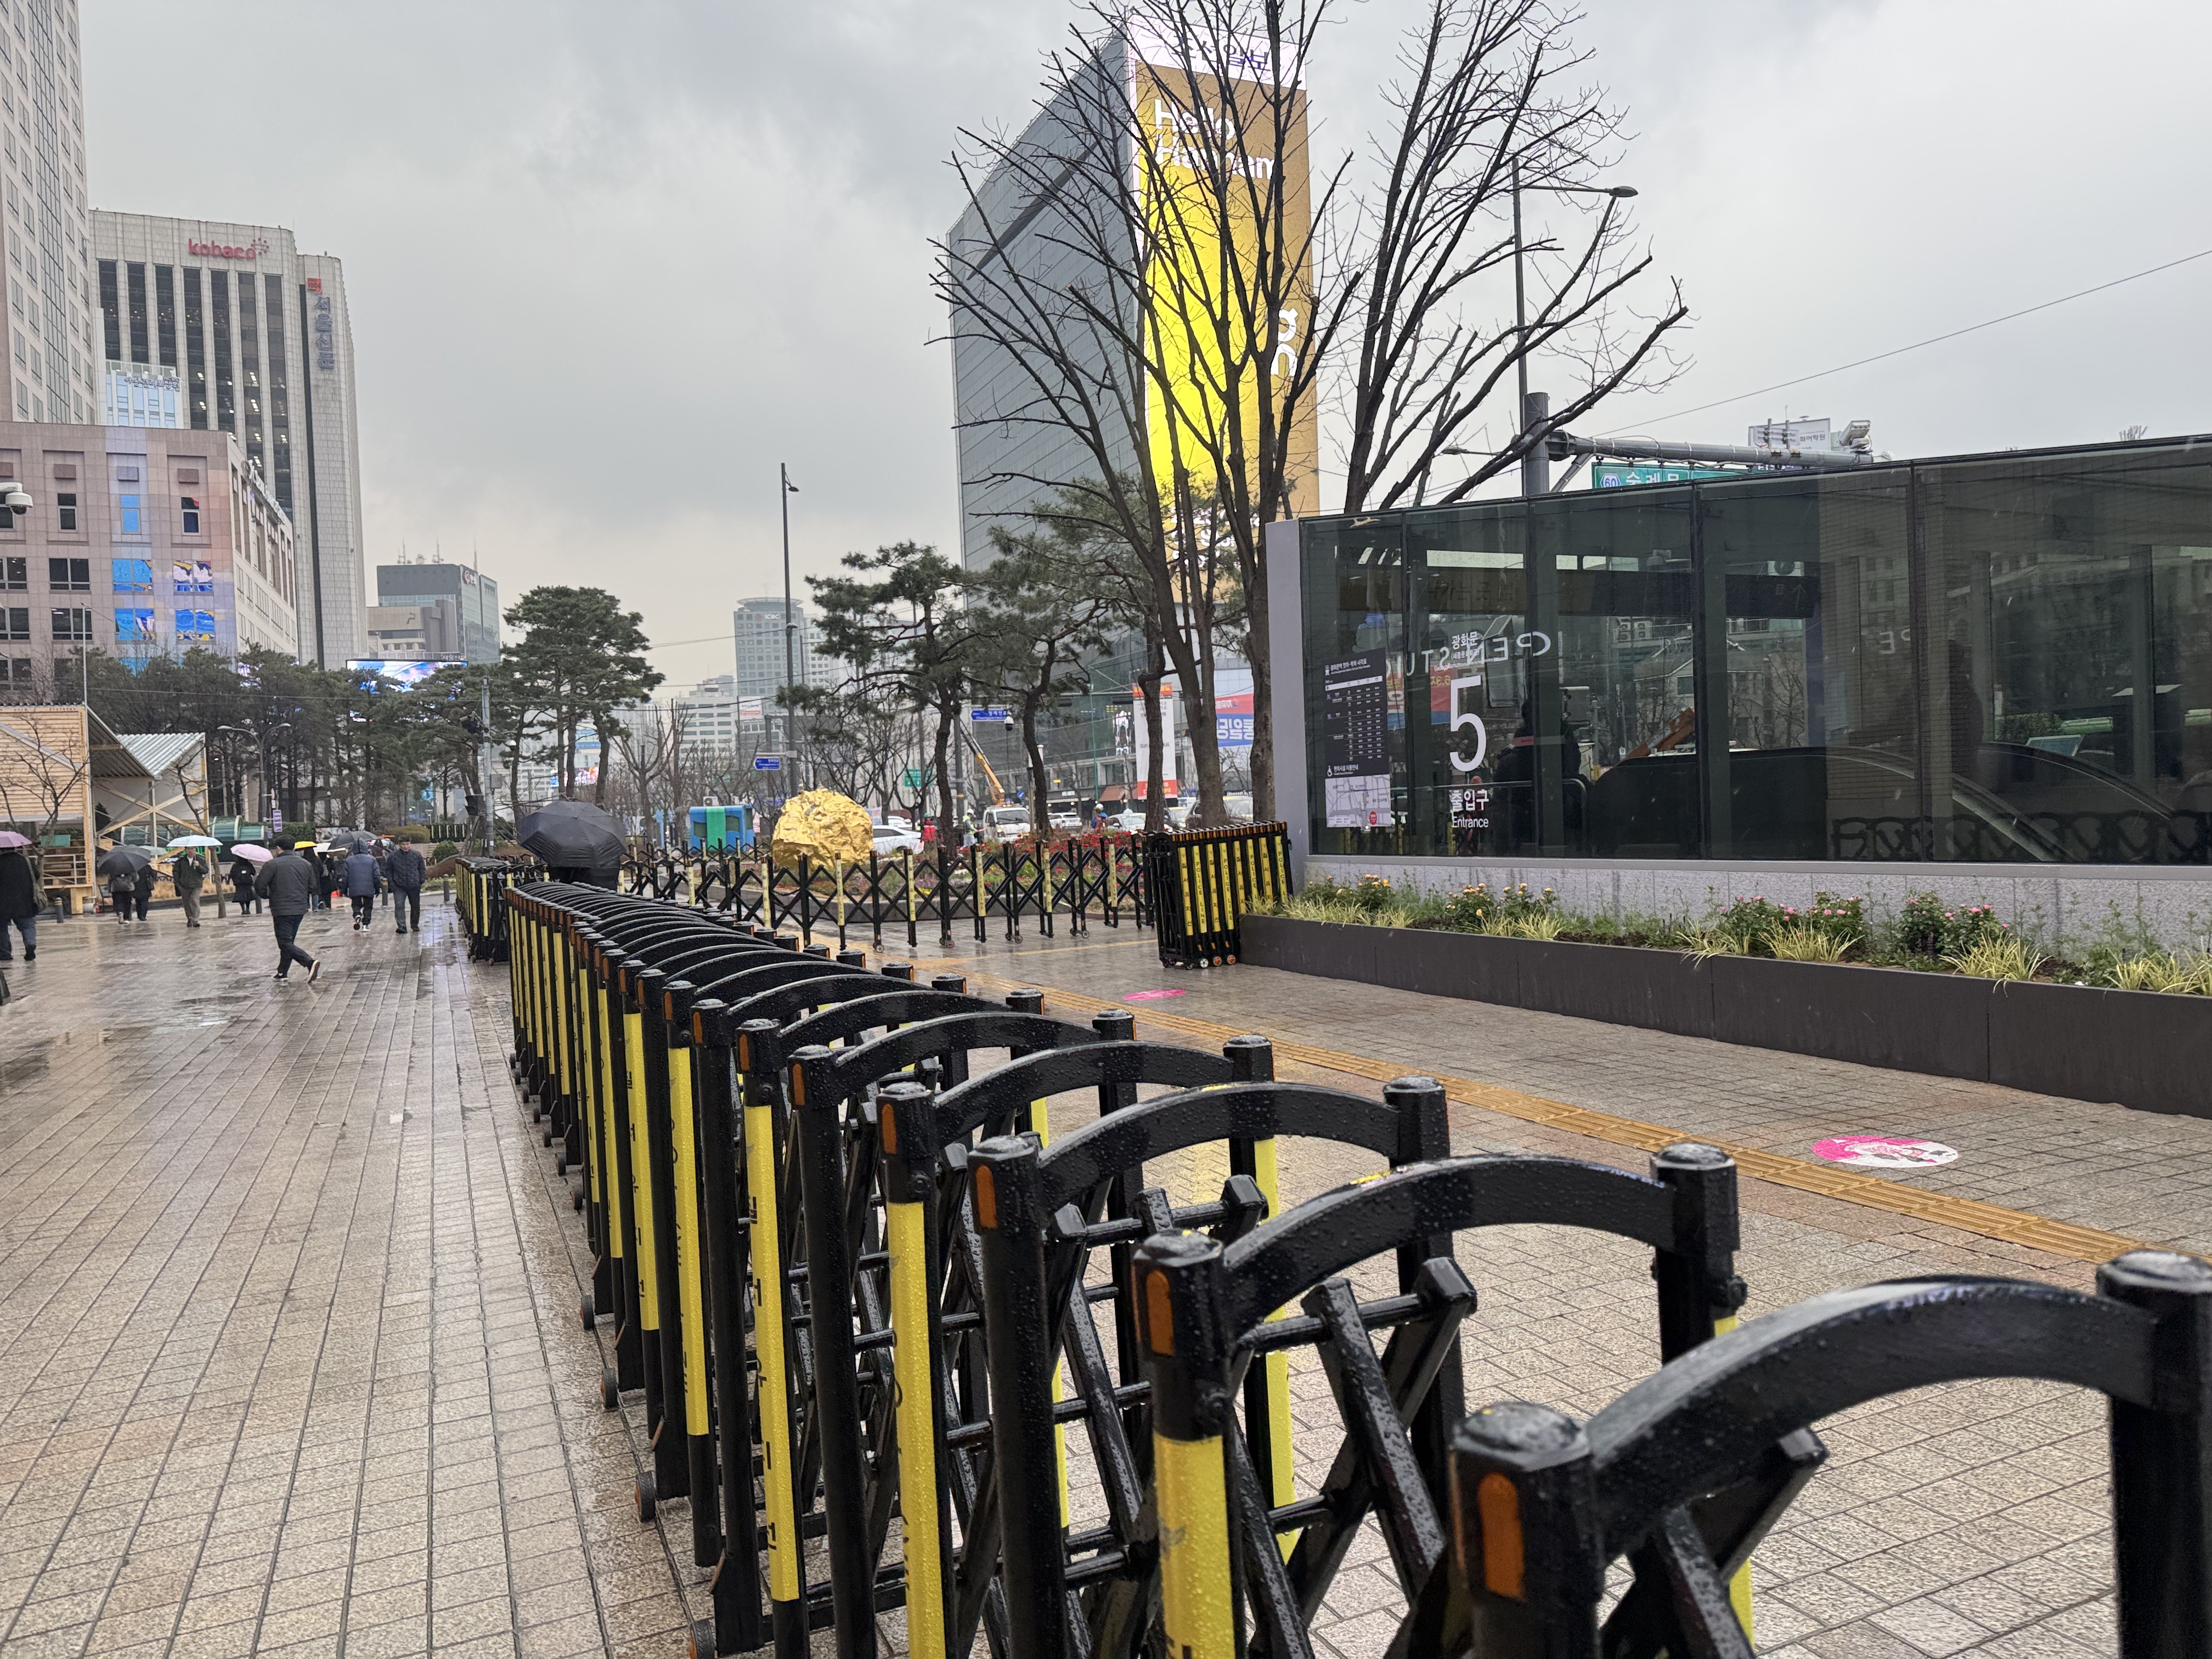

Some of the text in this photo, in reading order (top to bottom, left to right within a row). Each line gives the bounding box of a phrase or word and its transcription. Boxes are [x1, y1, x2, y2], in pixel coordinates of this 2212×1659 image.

[189, 238, 256, 259] kobaco
[314, 296, 335, 369] 서울신문
[1452, 631, 1479, 650] 광화문
[1450, 675, 1486, 772] 5
[1450, 789, 1489, 811] 출입구
[1452, 816, 1489, 828] Entrance
